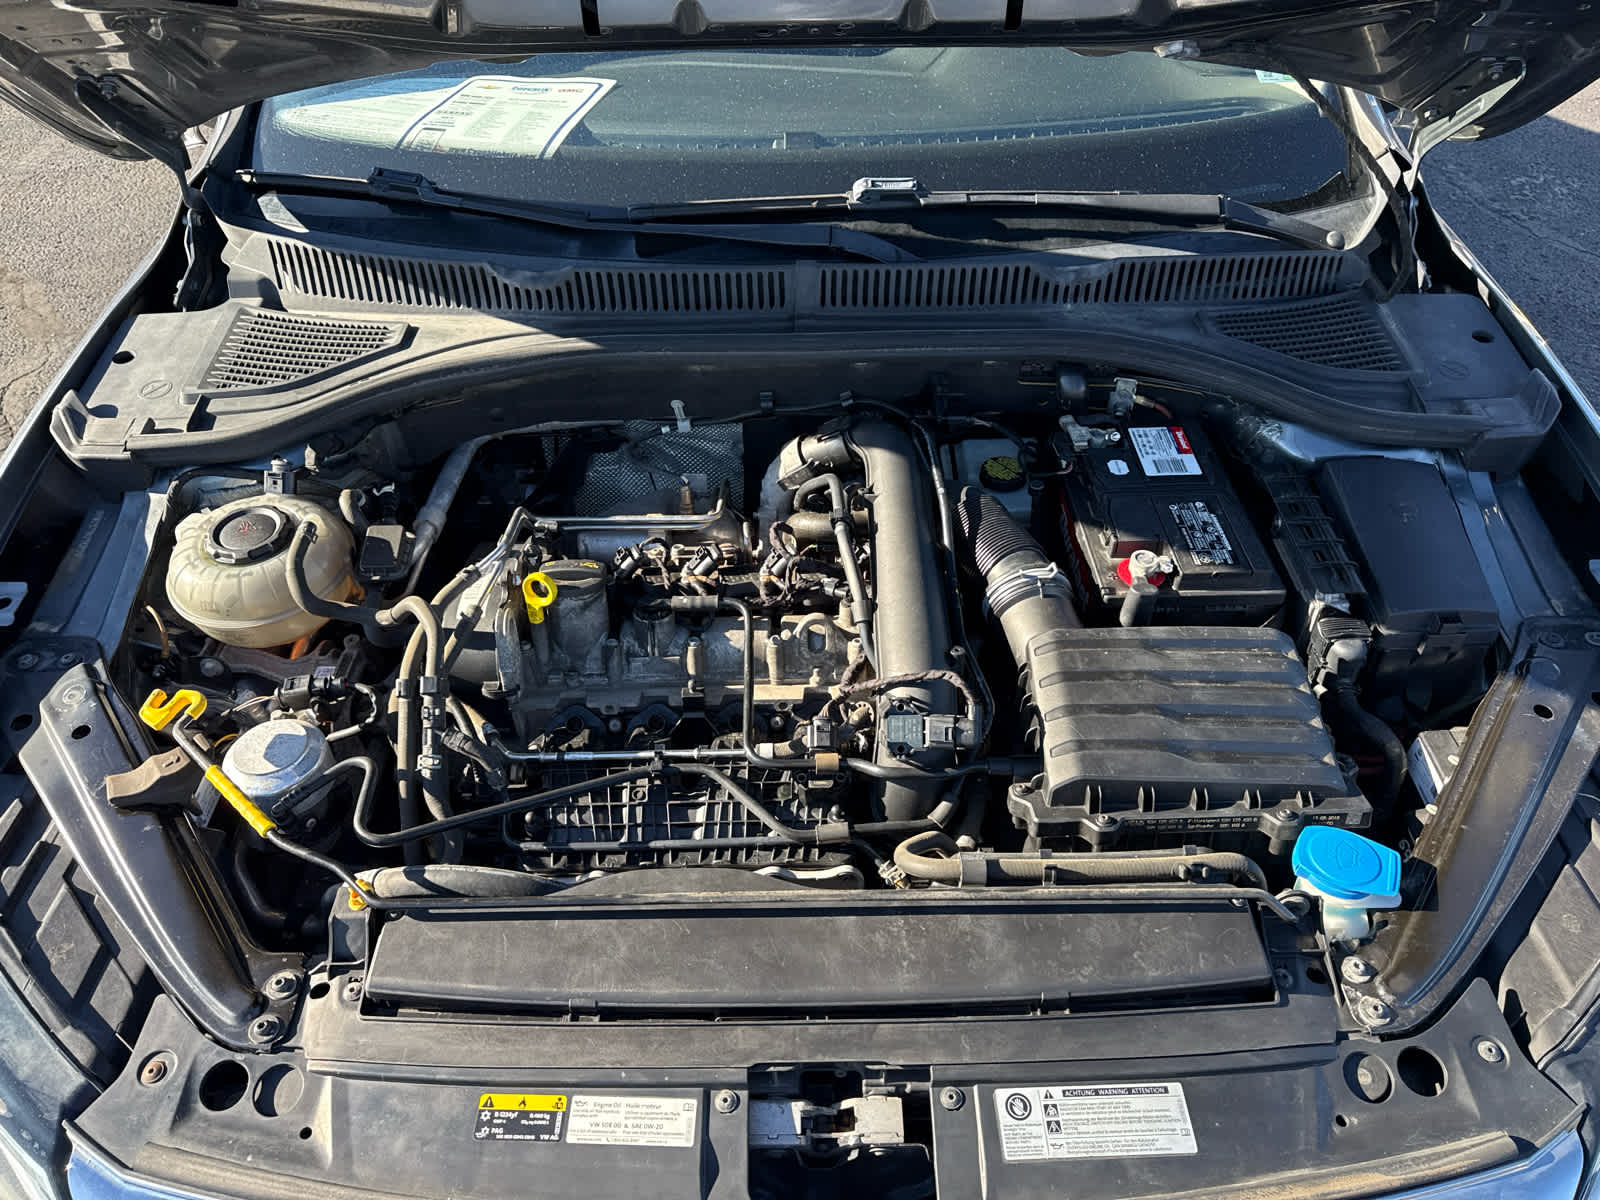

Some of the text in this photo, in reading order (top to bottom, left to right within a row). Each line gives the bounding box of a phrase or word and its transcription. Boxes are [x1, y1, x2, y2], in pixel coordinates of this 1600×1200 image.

[1065, 1087, 1165, 1097] ACHTUNG WARNING ATTENTION
